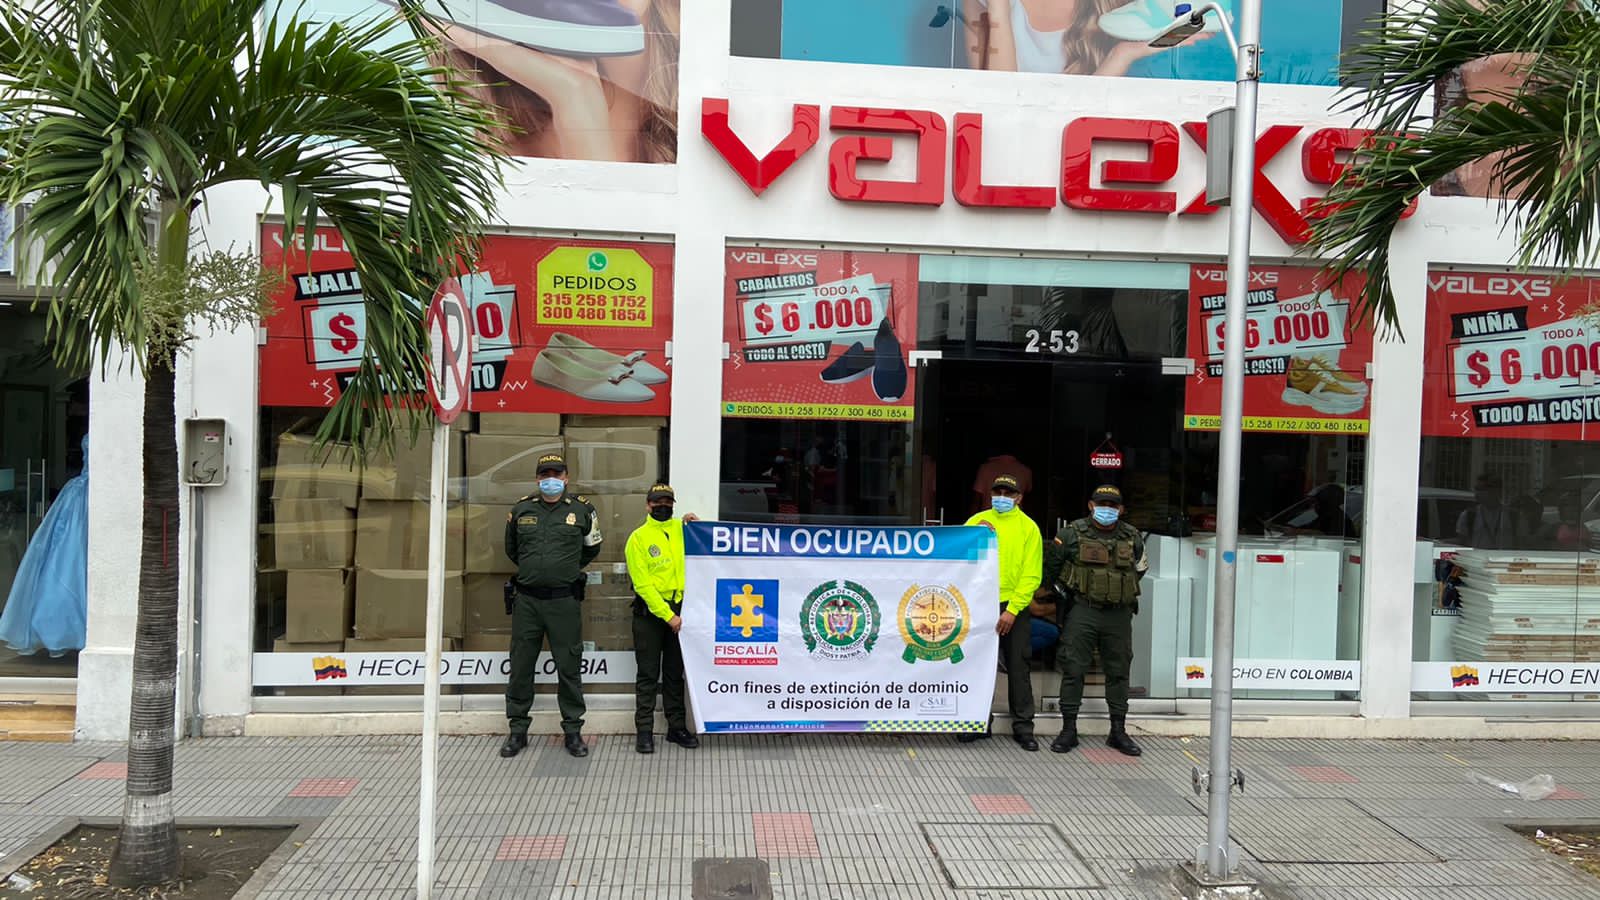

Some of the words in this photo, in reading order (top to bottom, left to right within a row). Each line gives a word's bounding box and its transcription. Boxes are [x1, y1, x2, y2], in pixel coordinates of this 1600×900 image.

[553, 275, 637, 291] PEDIDOS
[738, 272, 815, 292] CABALLEROS
[813, 286, 848, 297] TODO
[851, 285, 860, 295] A
[543, 293, 572, 305] 315
[576, 294, 607, 307] 258
[611, 295, 646, 308] 1752
[1202, 290, 1274, 309] DEPIVOS
[1277, 302, 1310, 312] TODO
[543, 307, 572, 319] 300
[576, 308, 606, 320] 480
[610, 309, 646, 321] 1854
[1463, 311, 1518, 335] NIÑA
[1025, 329, 1080, 353] 2-53
[1542, 328, 1574, 340] TODO
[1576, 328, 1585, 337] A
[747, 348, 775, 360] TODO
[777, 346, 789, 360] AL
[791, 342, 825, 359] COSTO
[1252, 357, 1285, 374] COSTO
[777, 407, 794, 415] 315
[798, 407, 813, 415] 258
[817, 408, 839, 416] 1752
[848, 408, 863, 417] 300
[867, 409, 882, 417] 480
[887, 409, 907, 418] 1854
[1479, 405, 1526, 424] TODO
[1527, 403, 1547, 422] AL
[1257, 419, 1272, 428] 258
[1276, 420, 1296, 429] 1752
[1305, 420, 1320, 429] 300
[1324, 421, 1339, 430] 480
[1343, 421, 1363, 431] 1854
[1091, 457, 1121, 466] CERRADO
[712, 526, 780, 553] BIEN
[790, 528, 935, 556] OCUPADO
[714, 643, 777, 655] FISCALÍA
[457, 659, 493, 676] EN
[1266, 668, 1286, 679] EN
[1290, 669, 1353, 681] COLOMBIA
[1488, 668, 1564, 685] HECHO
[1570, 669, 1600, 685] EN
[707, 680, 739, 694] Con
[744, 680, 782, 694] fines
[787, 681, 806, 694] de
[810, 681, 880, 694] extinción
[885, 681, 903, 694] de
[908, 681, 969, 694] dominio
[767, 699, 775, 709] a
[781, 697, 870, 712] disposición
[874, 697, 893, 710] de
[897, 697, 910, 709] la
